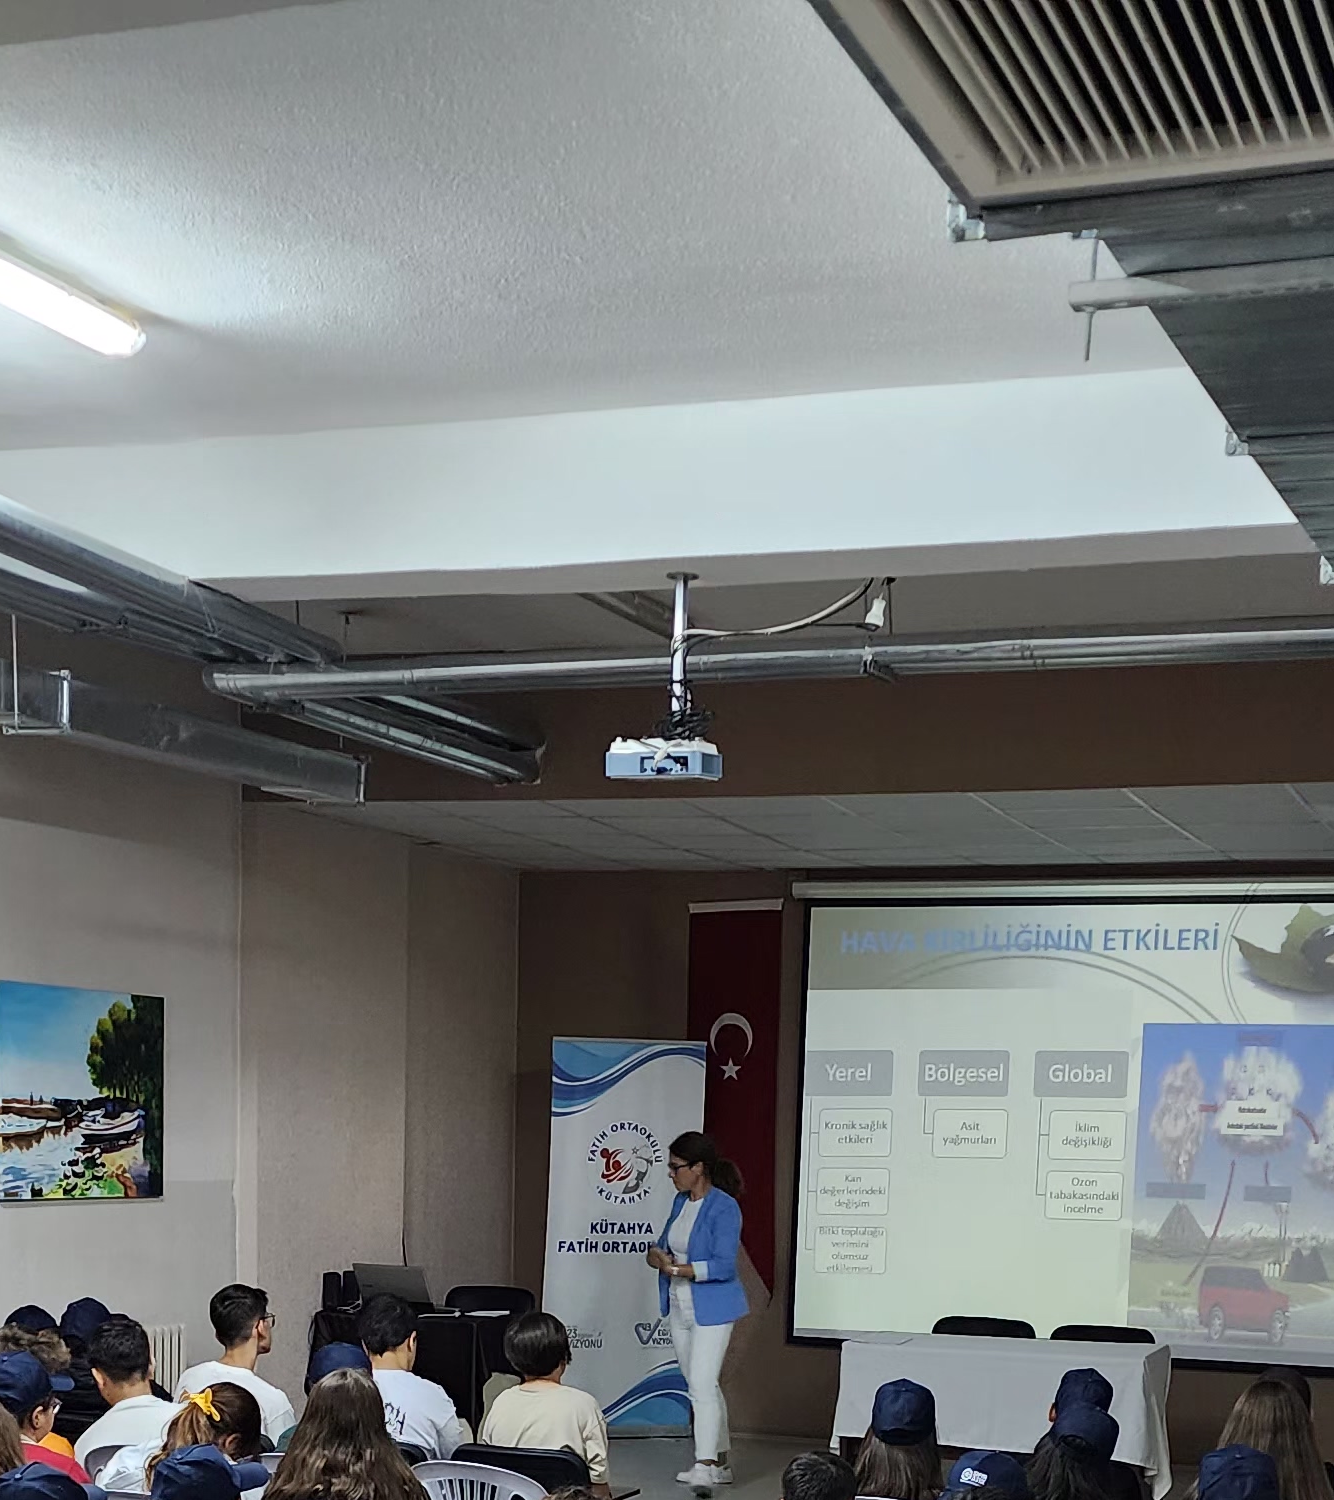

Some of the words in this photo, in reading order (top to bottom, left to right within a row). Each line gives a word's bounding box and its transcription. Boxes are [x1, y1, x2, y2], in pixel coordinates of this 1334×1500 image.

[1102, 922, 1220, 952] ETKİLERİ
[825, 1063, 872, 1082] Yerel
[924, 1063, 1004, 1086] Bölgesel
[1048, 1063, 1113, 1083] Global
[824, 1120, 857, 1130] Kronik
[960, 1121, 980, 1131] Asit
[1074, 1121, 1100, 1133] İklim
[610, 1121, 664, 1163] ORTAOKULU
[837, 1134, 874, 1144] etkileri
[942, 1135, 997, 1147] yağmurları
[1061, 1136, 1113, 1148] değişikliği
[844, 1175, 862, 1183] Kan
[1071, 1177, 1098, 1187] Ozon
[819, 1187, 886, 1197] değerlerindeki
[1049, 1190, 1119, 1201] tabakasındaki
[834, 1199, 870, 1209] değişim
[1063, 1203, 1104, 1213] incelme
[590, 1218, 654, 1235] KÜTAHYA
[557, 1237, 599, 1253] FATİH
